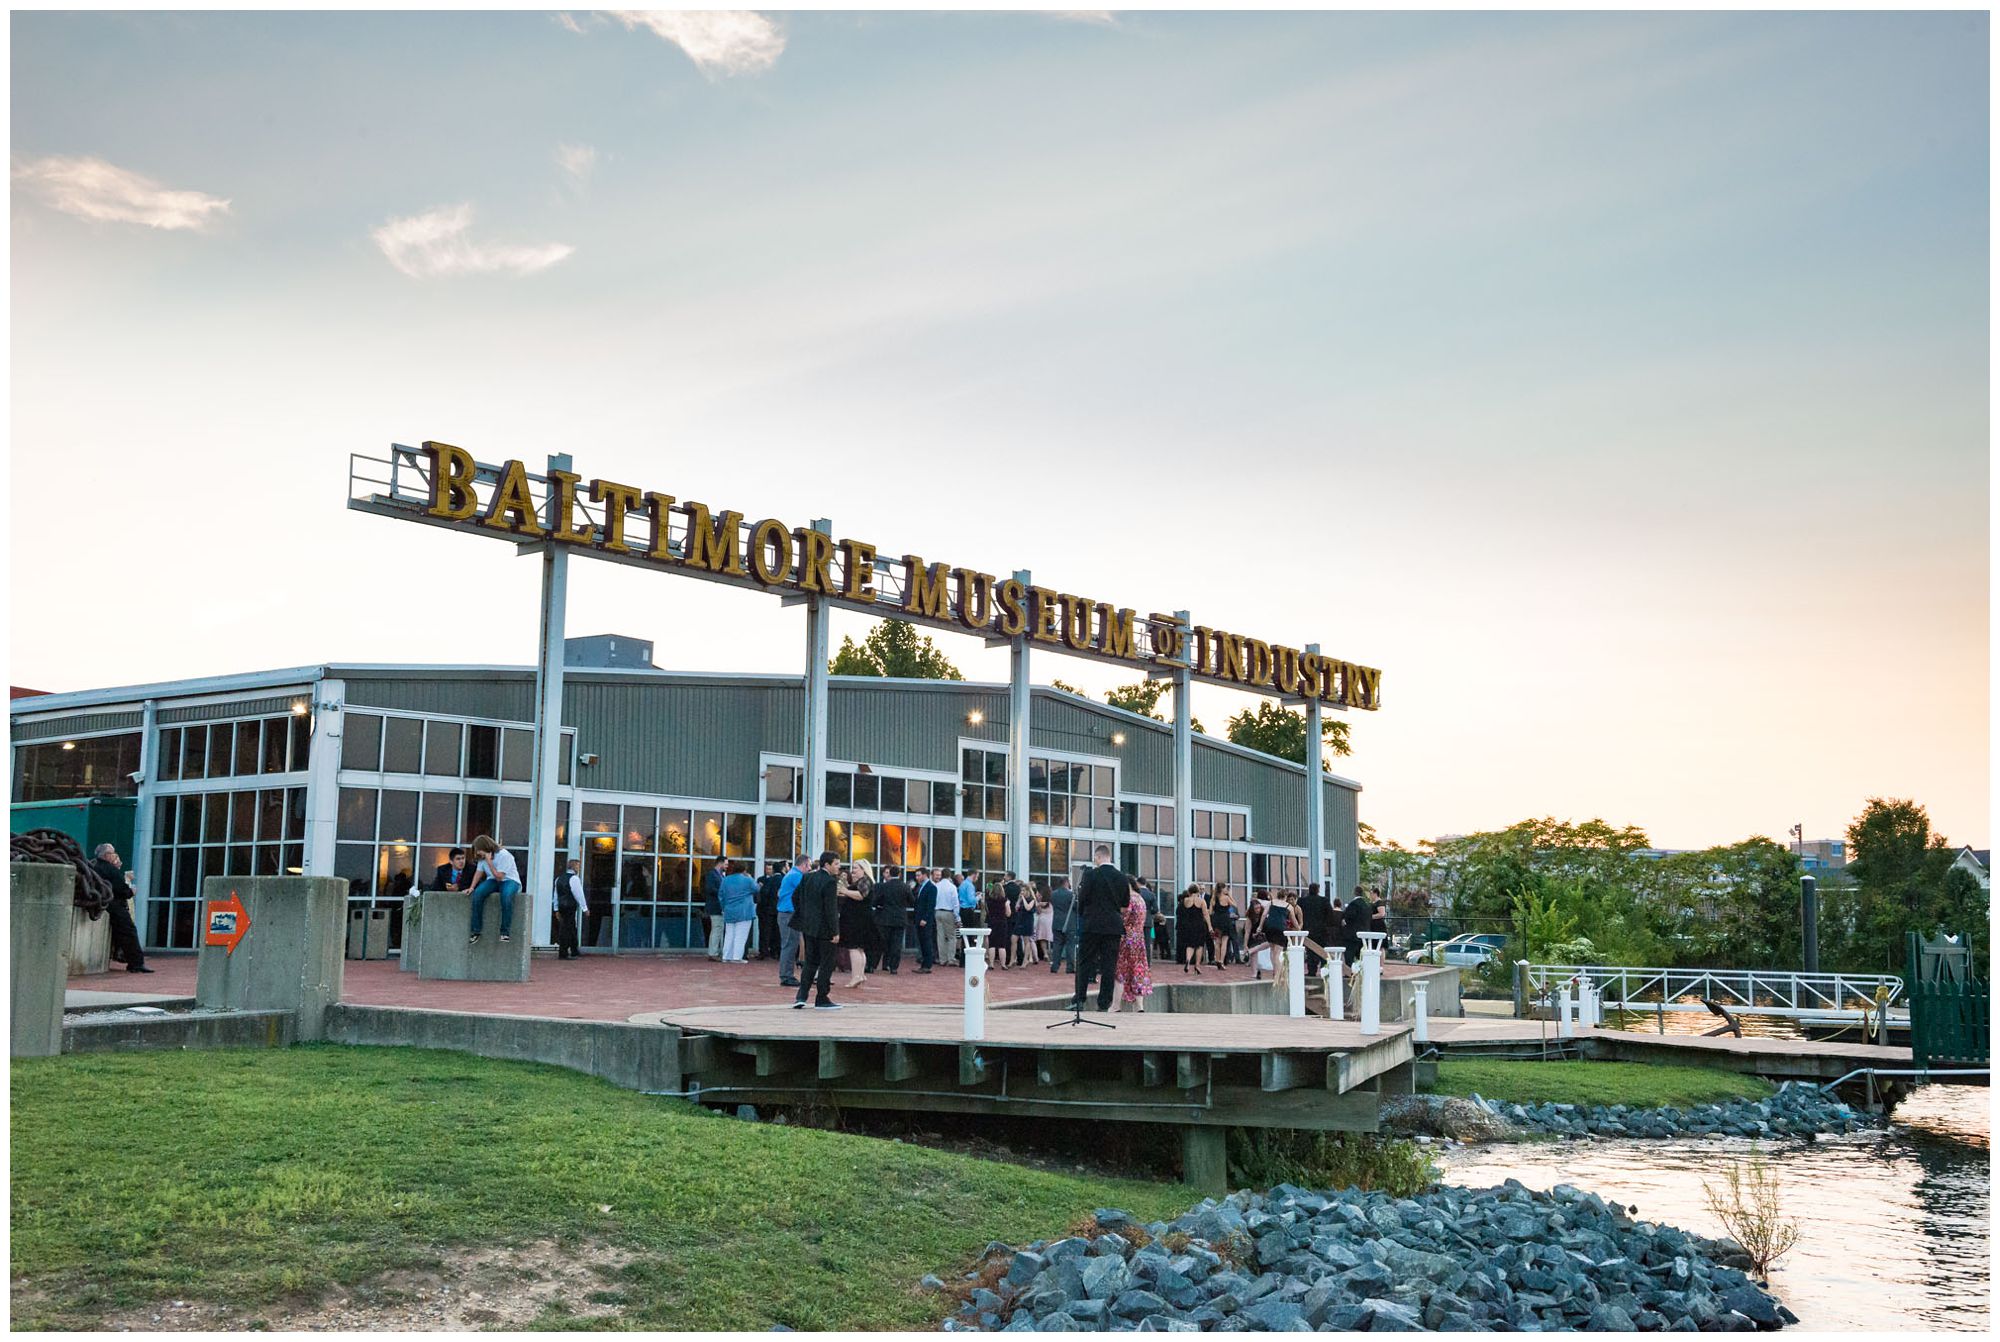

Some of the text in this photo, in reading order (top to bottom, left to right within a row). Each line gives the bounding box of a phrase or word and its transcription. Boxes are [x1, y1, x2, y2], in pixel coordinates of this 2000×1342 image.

[422, 440, 1381, 710] BALTIMORE MUSEUM OF INDUSTRY
